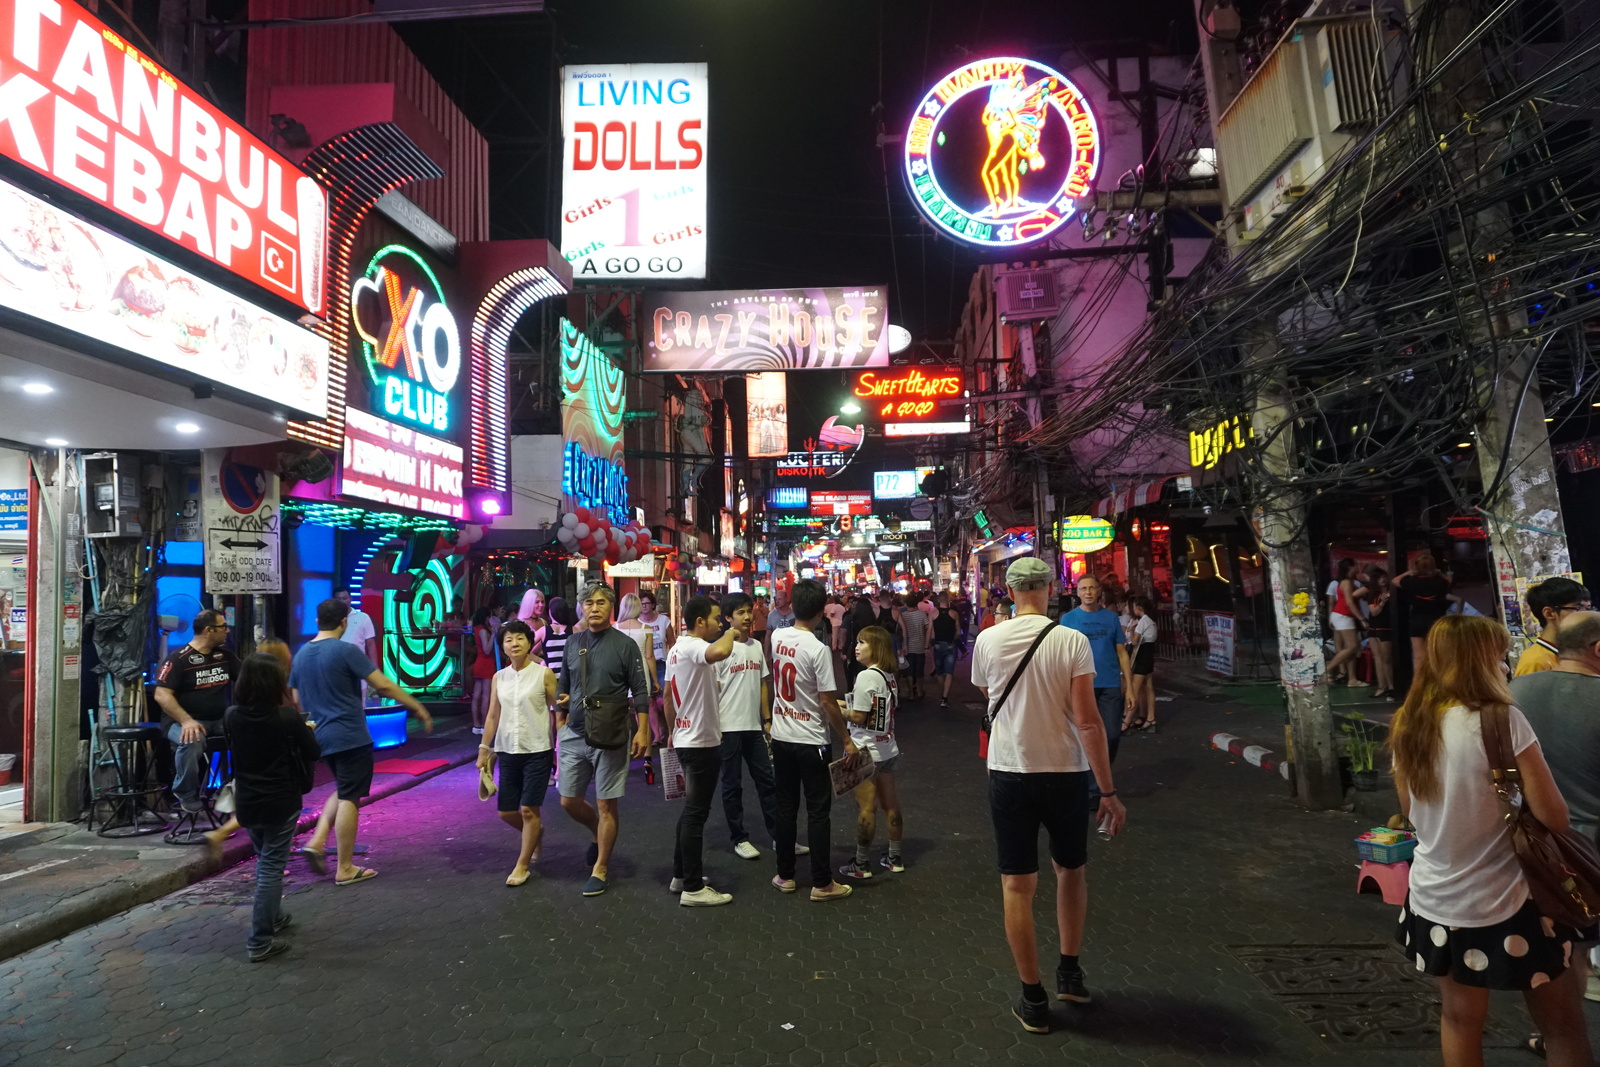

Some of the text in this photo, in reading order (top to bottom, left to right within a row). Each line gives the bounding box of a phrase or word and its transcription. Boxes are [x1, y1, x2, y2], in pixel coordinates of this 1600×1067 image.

[578, 78, 691, 107] LIVING
[934, 62, 1028, 104] HAPPY
[572, 119, 703, 171] DOLLS
[653, 184, 694, 201] Girls
[564, 196, 612, 224] Girls
[613, 188, 649, 247] 1
[653, 224, 702, 246] Girls
[564, 240, 606, 262] Girls
[581, 257, 683, 274] A GO GO
[710, 300, 729, 308] THE
[734, 296, 776, 304] ASYLUM
[798, 297, 819, 306] FUN
[378, 265, 461, 393] XO
[653, 303, 878, 356] CRAZY HOUSE
[384, 375, 449, 431] CLUB
[881, 401, 934, 417] A GOGO
[876, 474, 899, 490] P72
[1083, 529, 1103, 537] BAR
[240, 558, 254, 566] ODD
[256, 558, 272, 566] DATE
[773, 659, 797, 703] 10
